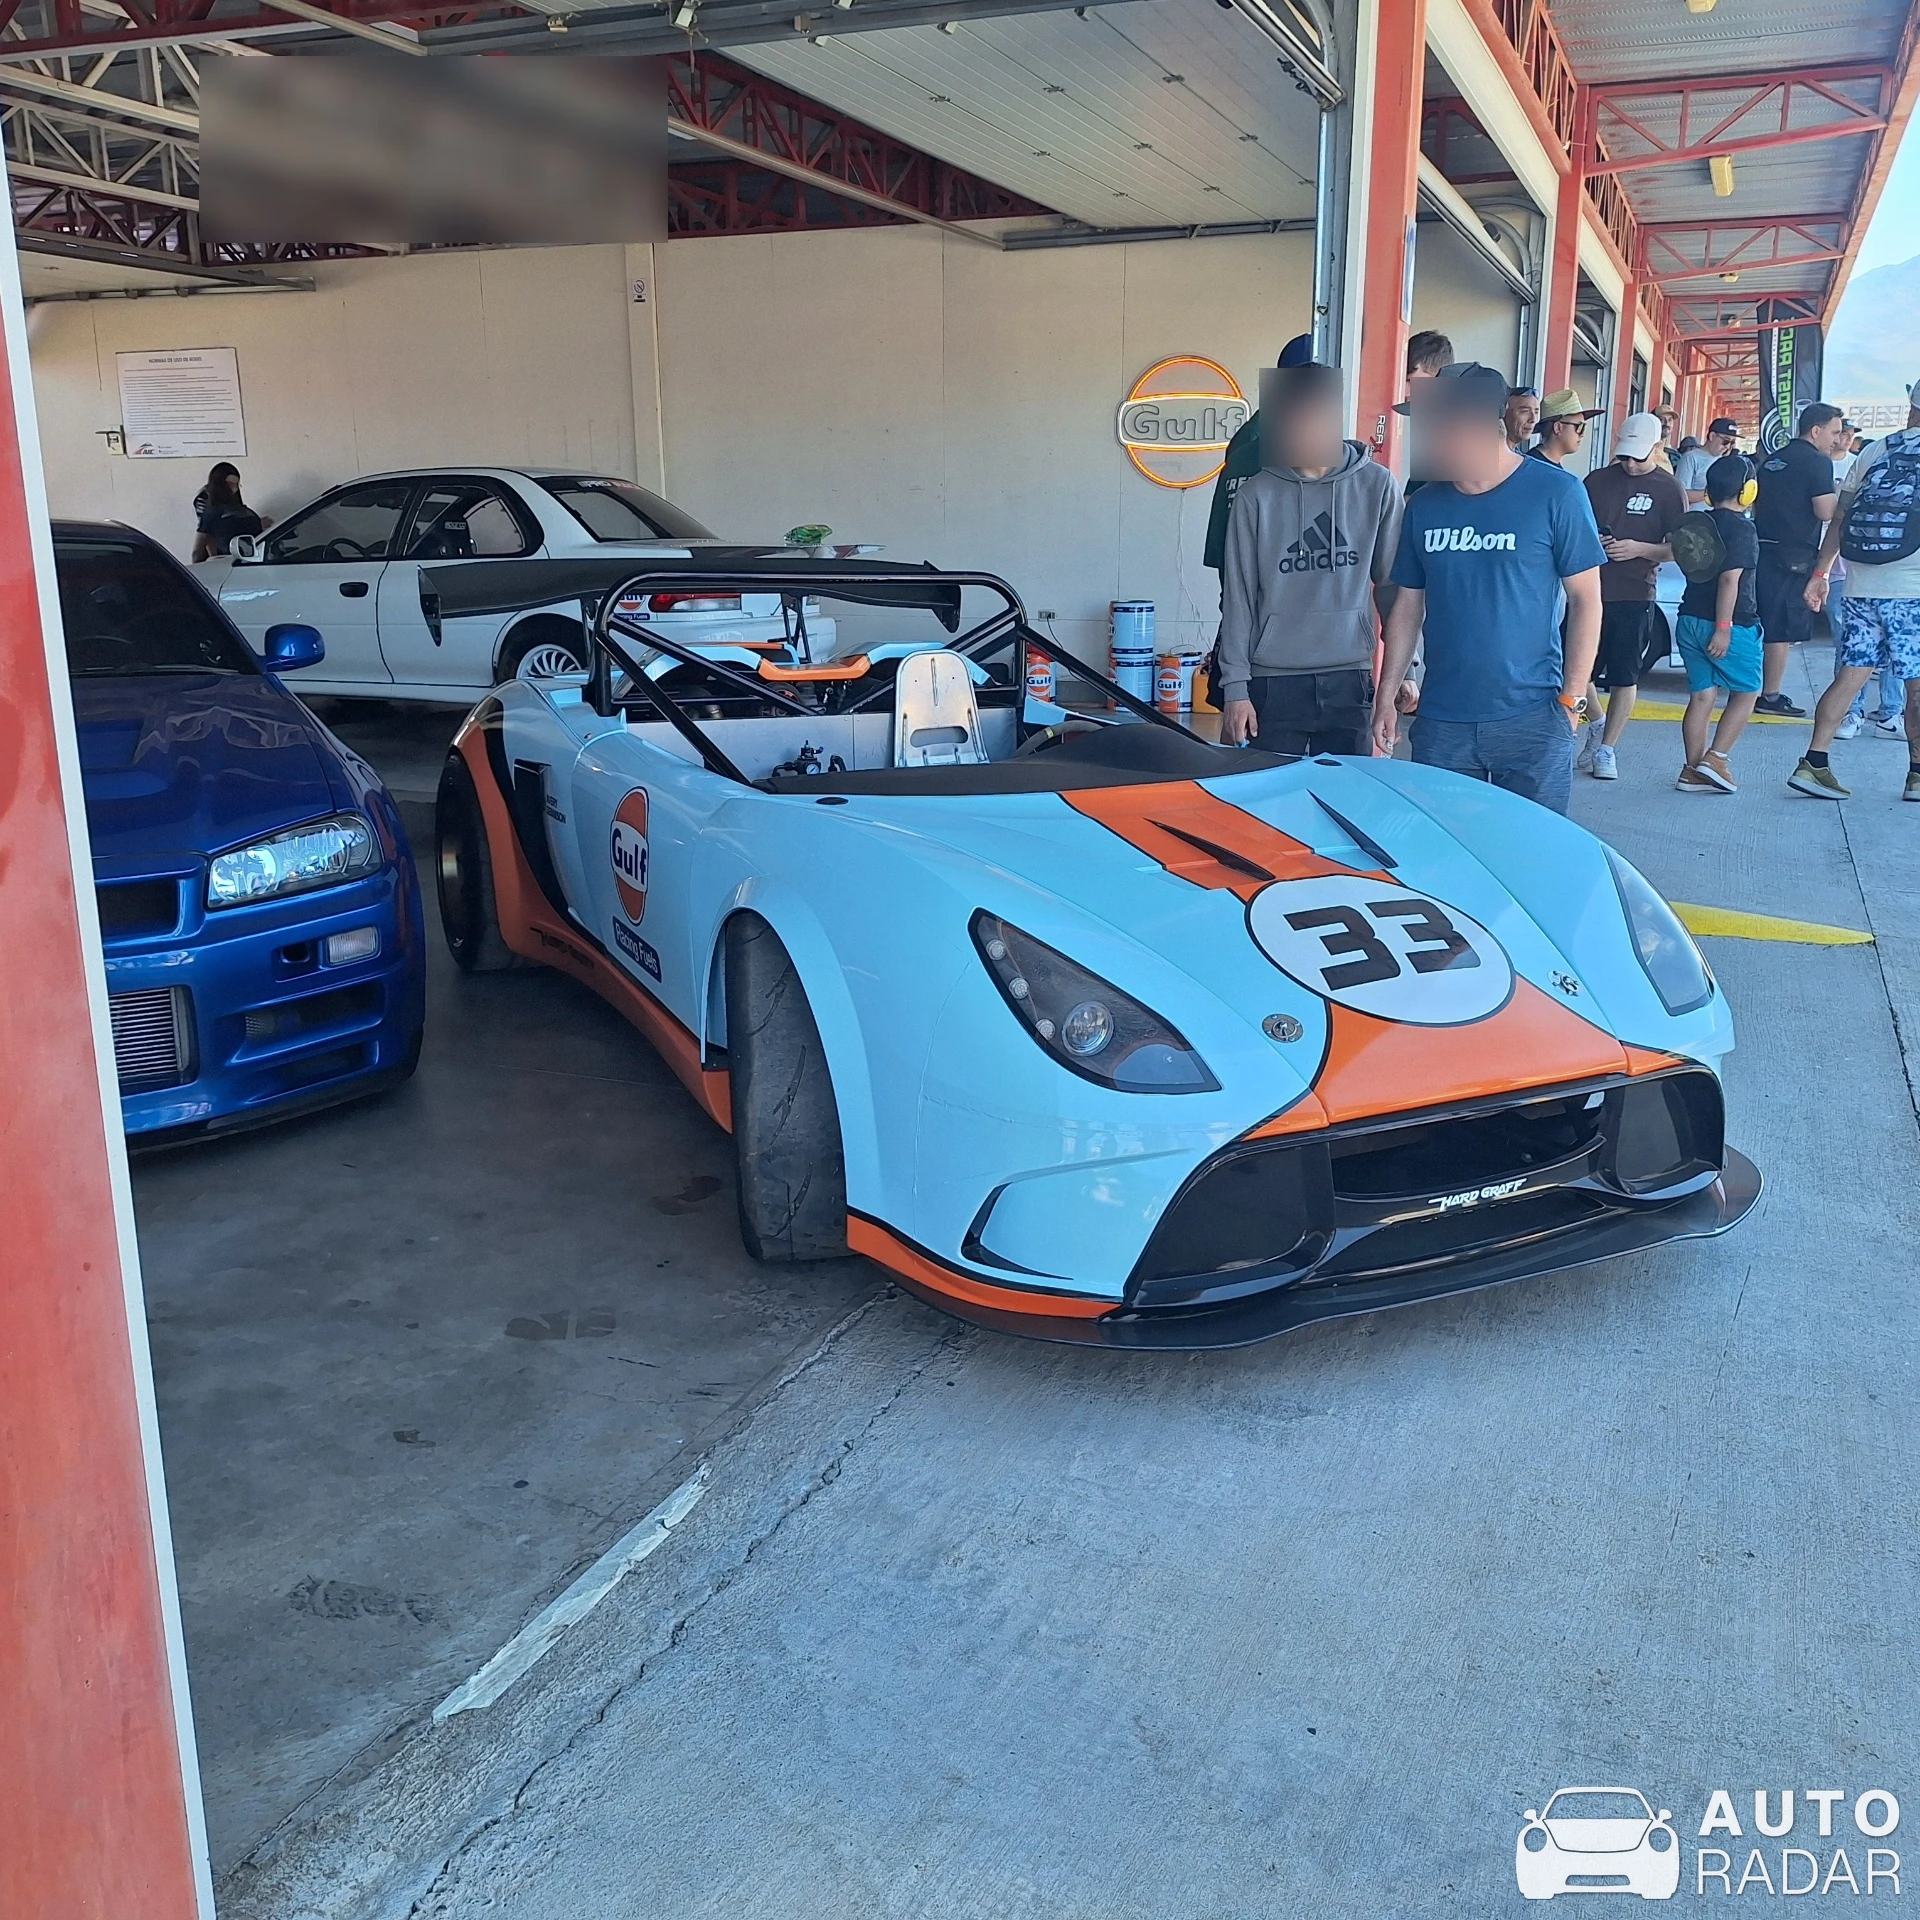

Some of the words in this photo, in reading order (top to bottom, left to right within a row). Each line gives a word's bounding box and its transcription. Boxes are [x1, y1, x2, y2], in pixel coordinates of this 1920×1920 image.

[1123, 403, 1245, 441] Gulf
[1424, 526, 1516, 553] Wilson
[1278, 549, 1360, 574] adidas
[1026, 675, 1052, 685] Gulf
[1157, 679, 1184, 690] Gulf
[611, 827, 647, 886] Gulf
[615, 922, 640, 962] Racing
[639, 941, 659, 974] Fuels
[1283, 898, 1482, 992] 33
[1427, 1190, 1480, 1213] HARD
[1480, 1177, 1528, 1199] GRAFF
